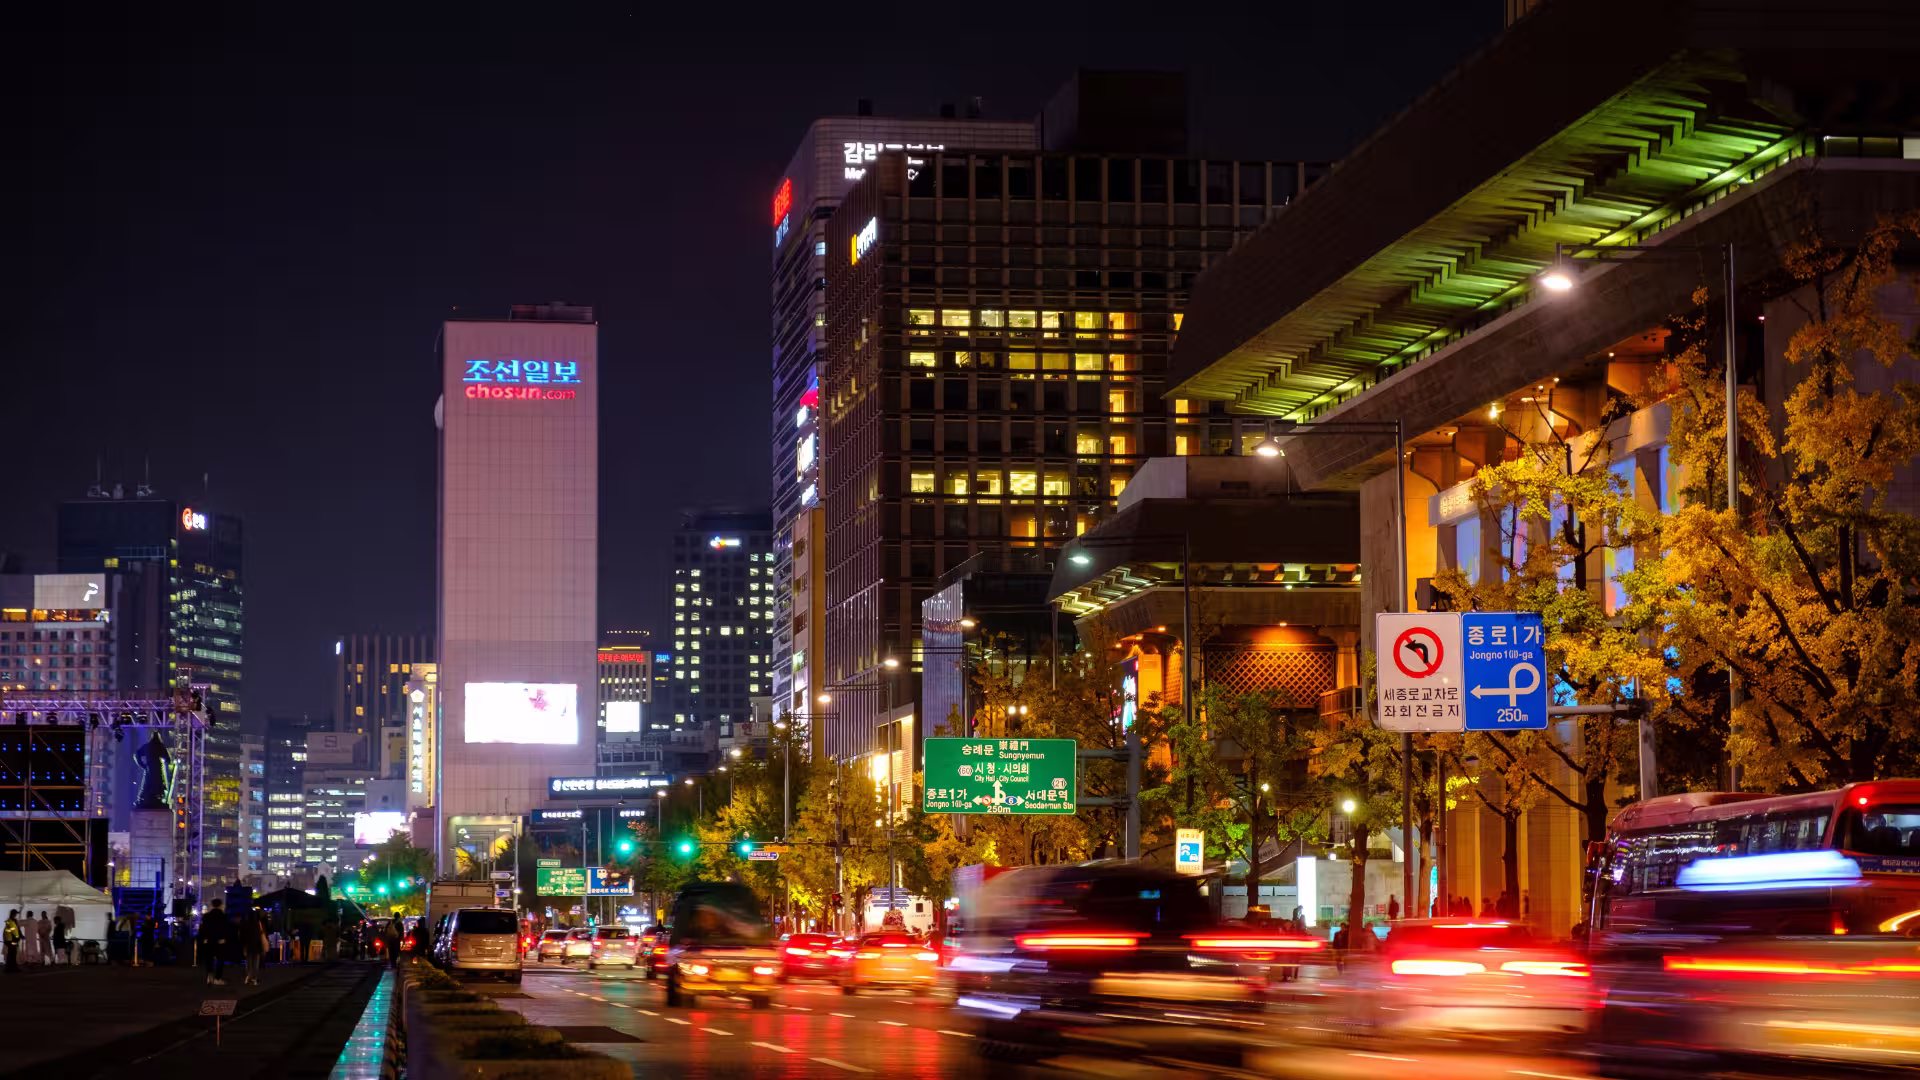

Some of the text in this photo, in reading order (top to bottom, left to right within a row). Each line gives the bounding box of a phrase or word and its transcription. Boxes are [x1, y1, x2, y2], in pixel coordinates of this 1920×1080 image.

[462, 360, 581, 384] 조선일보
[465, 384, 576, 400] chosun.com
[1468, 625, 1542, 645] 종로1가
[1469, 650, 1503, 662] Jongno
[1384, 687, 1459, 701] 세종로교차로
[1497, 708, 1529, 723] 250m
[999, 751, 1045, 760] Sungnyemun
[974, 775, 985, 783] City
[1010, 775, 1029, 783] Council
[926, 788, 967, 800] 종로1가
[1025, 790, 1068, 801] 서대문역
[926, 800, 950, 808] Jongno
[987, 805, 1011, 813] 250m
